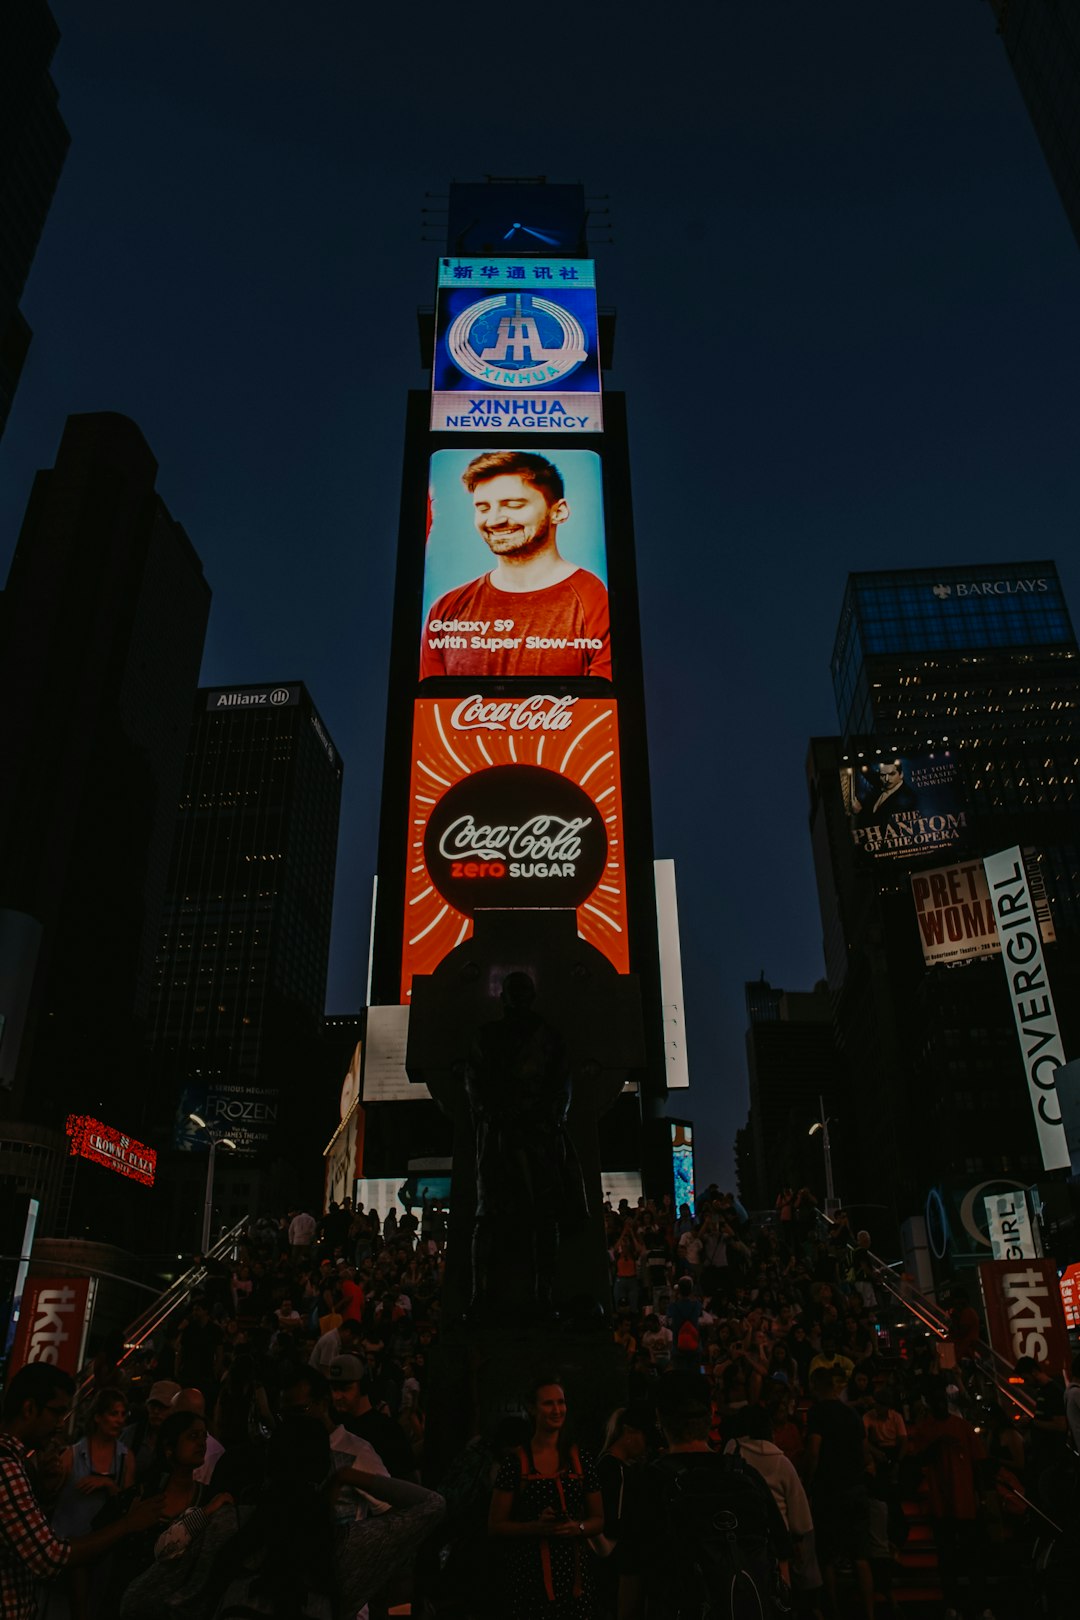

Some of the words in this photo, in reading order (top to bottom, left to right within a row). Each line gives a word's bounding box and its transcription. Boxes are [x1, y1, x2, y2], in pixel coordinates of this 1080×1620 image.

[453, 265, 579, 280] 新华通讯社
[480, 366, 560, 384] XINHUA
[468, 399, 567, 415] XINHUA
[446, 416, 502, 427] NEWS
[508, 416, 588, 428] AGENCY
[956, 578, 1048, 597] BARCLAYS
[428, 619, 491, 635] Galaxy
[494, 619, 515, 632] S9
[428, 634, 468, 650] with
[470, 636, 522, 653] Super
[525, 636, 603, 650] Slow-mo
[216, 693, 267, 706] Allianz
[450, 694, 579, 731] Coca-Cola
[892, 810, 921, 822] THE
[438, 814, 593, 861] Coca-Cola
[851, 811, 968, 847] PHANTOM
[864, 841, 884, 853] OF
[884, 836, 913, 849] THE
[913, 828, 961, 845] OPERA
[450, 862, 505, 878] zero
[509, 862, 576, 878] SUGAR
[912, 863, 984, 913] PRET
[205, 1095, 279, 1121] FROZEN
[128, 1152, 153, 1173] PLAZA
[1002, 1267, 1053, 1362] tkts
